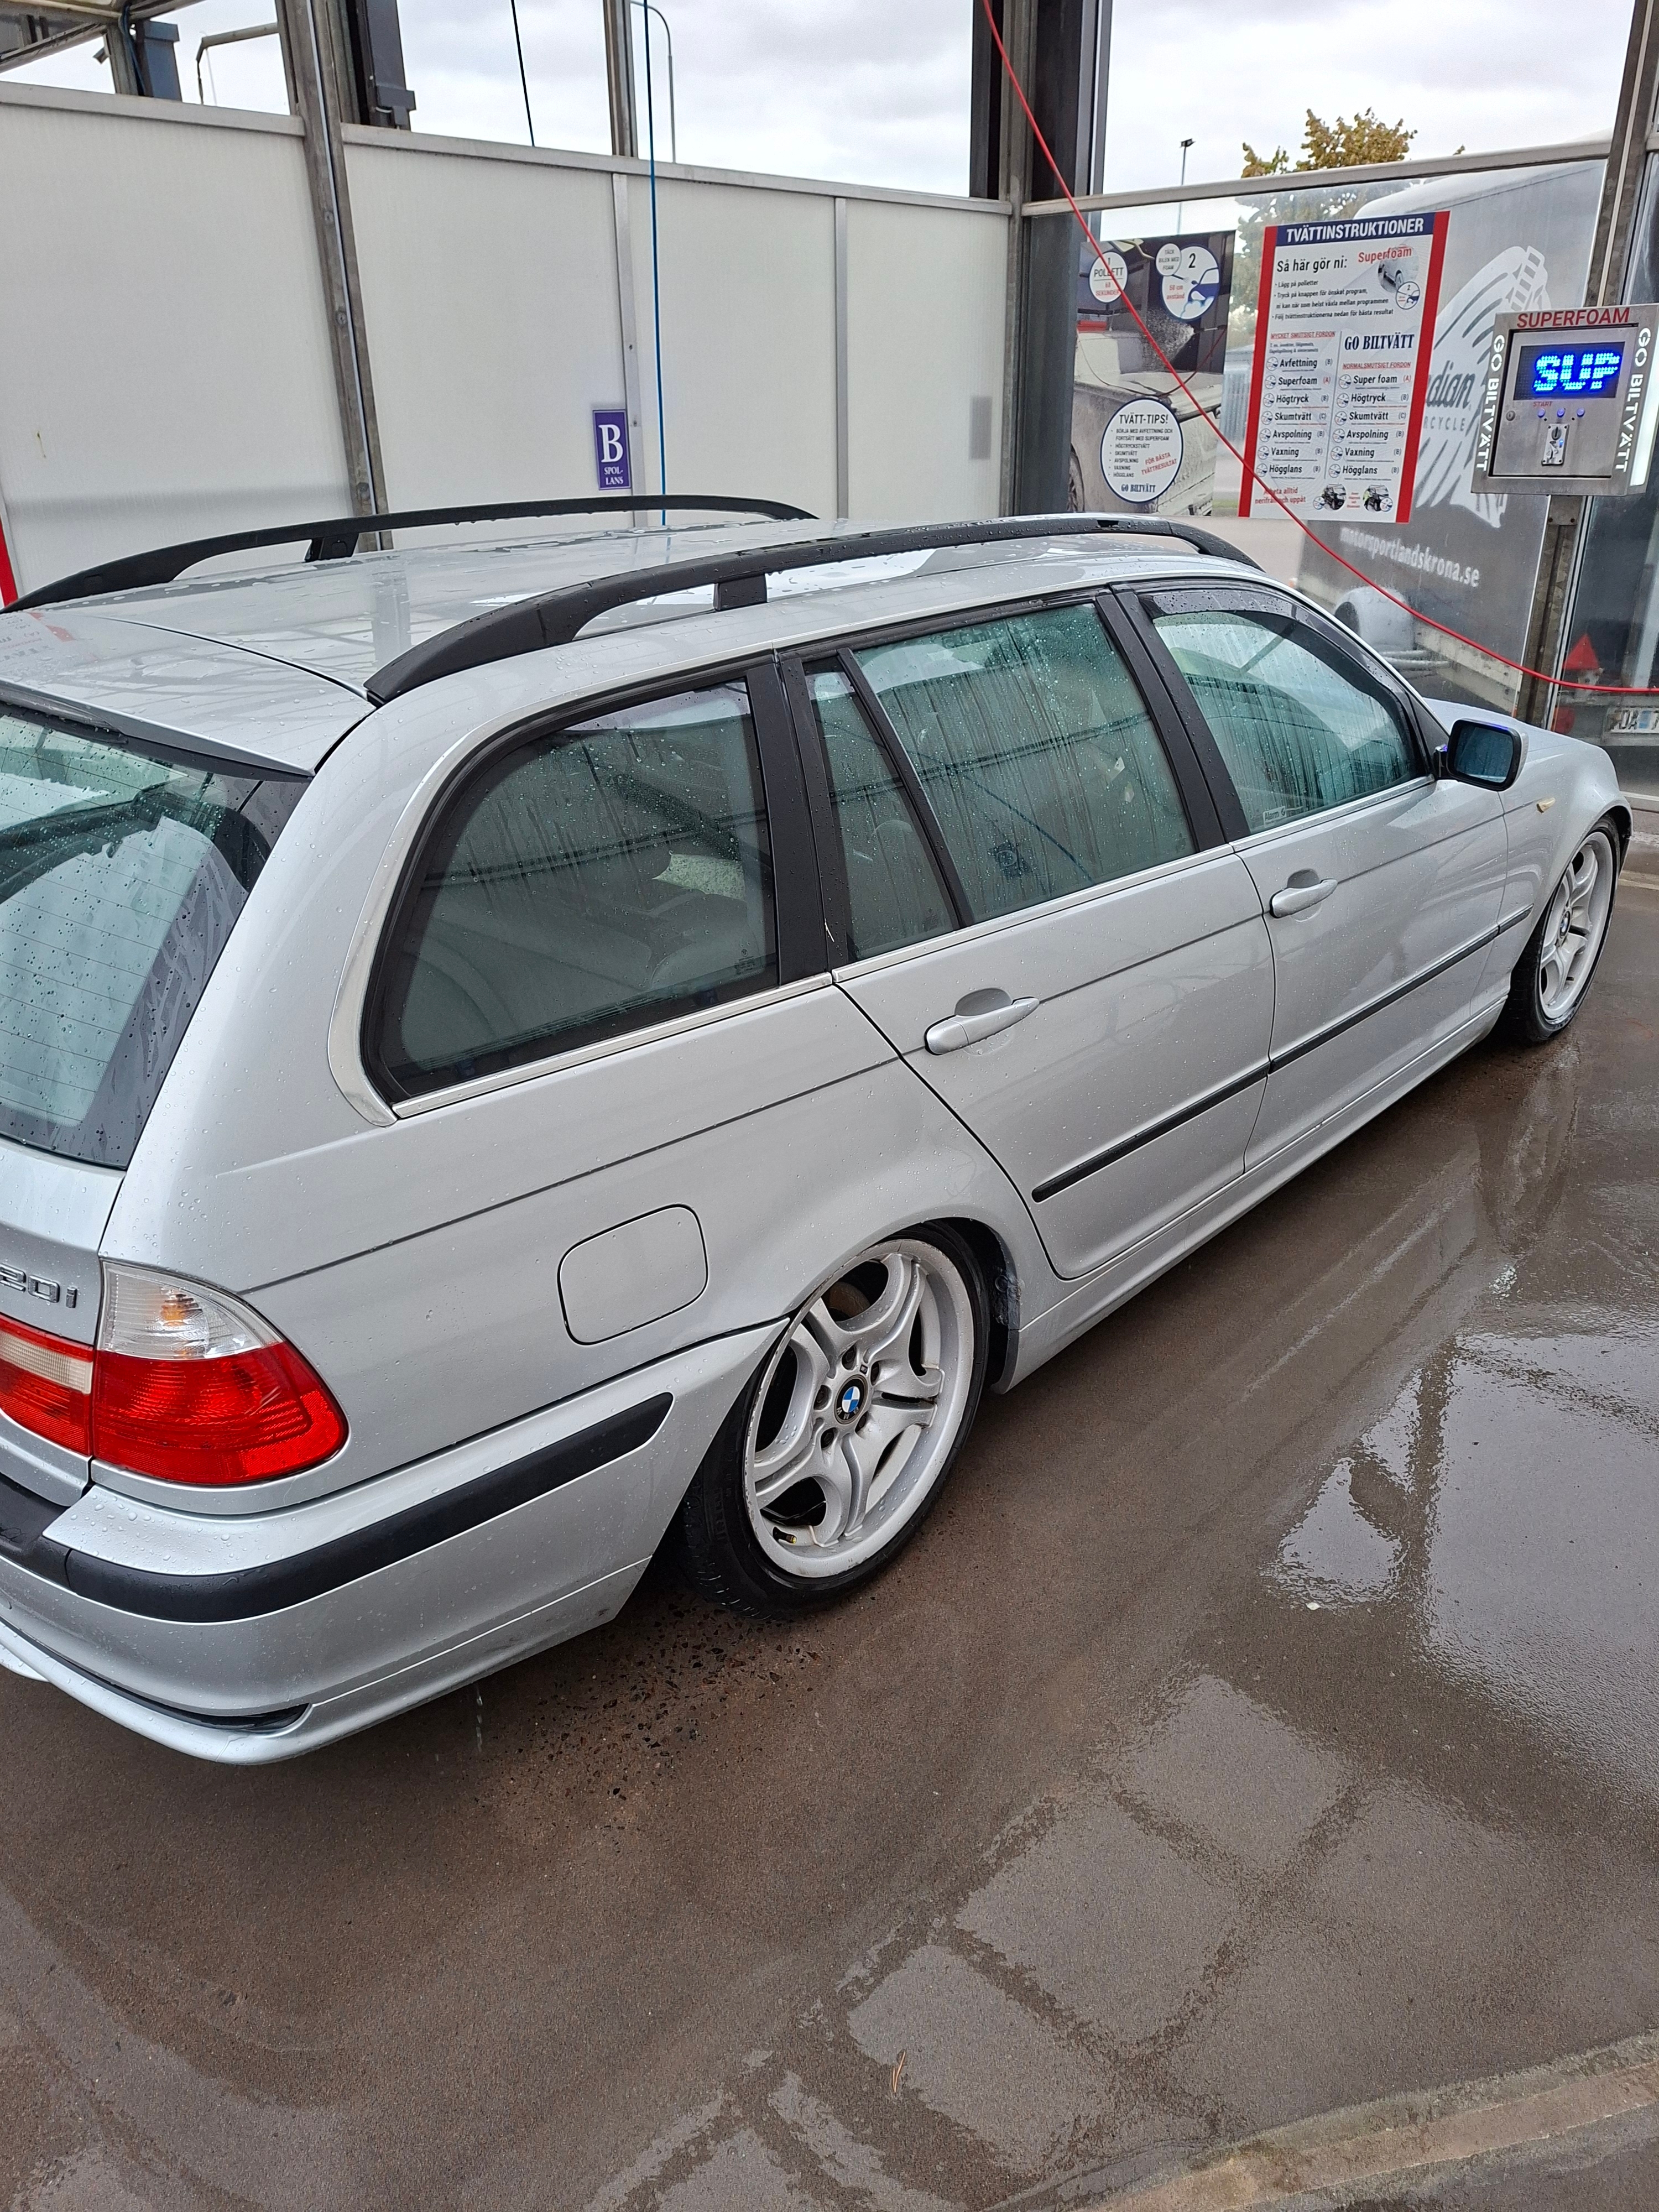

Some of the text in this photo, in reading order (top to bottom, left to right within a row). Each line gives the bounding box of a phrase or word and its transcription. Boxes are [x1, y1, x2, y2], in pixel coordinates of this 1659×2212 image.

[1286, 218, 1424, 242] TVÄTTINSTRUKTIONER
[1188, 253, 1196, 268] 2
[1358, 247, 1412, 264] Superfoam
[1277, 255, 1347, 273] Så här gör ni:
[1516, 307, 1630, 328] SUPERFOAM
[1344, 332, 1415, 350] GO BILTVÄTT
[1634, 327, 1651, 367] GO
[1490, 334, 1505, 372] GO
[1280, 358, 1317, 369] Avfettning
[1533, 352, 1620, 392] SUP
[1278, 376, 1318, 387] Superfoam
[1353, 375, 1375, 385] Super
[1378, 374, 1397, 383] foam
[1426, 360, 1475, 409] dian
[1276, 393, 1310, 405] Högtryck
[1351, 393, 1386, 404] Högtryck
[1119, 412, 1168, 424] TVÄTT-TIPS!
[1275, 412, 1312, 421] Skumtvätt
[1349, 411, 1389, 420] Skumtvätt
[1476, 378, 1499, 472] BILTVÄTT
[1615, 373, 1644, 473] BILTVÄTT
[1272, 429, 1312, 440] Avspolning
[1347, 429, 1389, 441] Avspolning
[598, 424, 623, 462] B
[1271, 446, 1300, 458] Vaxning
[1345, 447, 1375, 458] Vaxning
[604, 466, 624, 475] SPOL-
[1269, 464, 1303, 475] Högglans
[1343, 465, 1378, 476] Högglans
[605, 476, 624, 485] LANS
